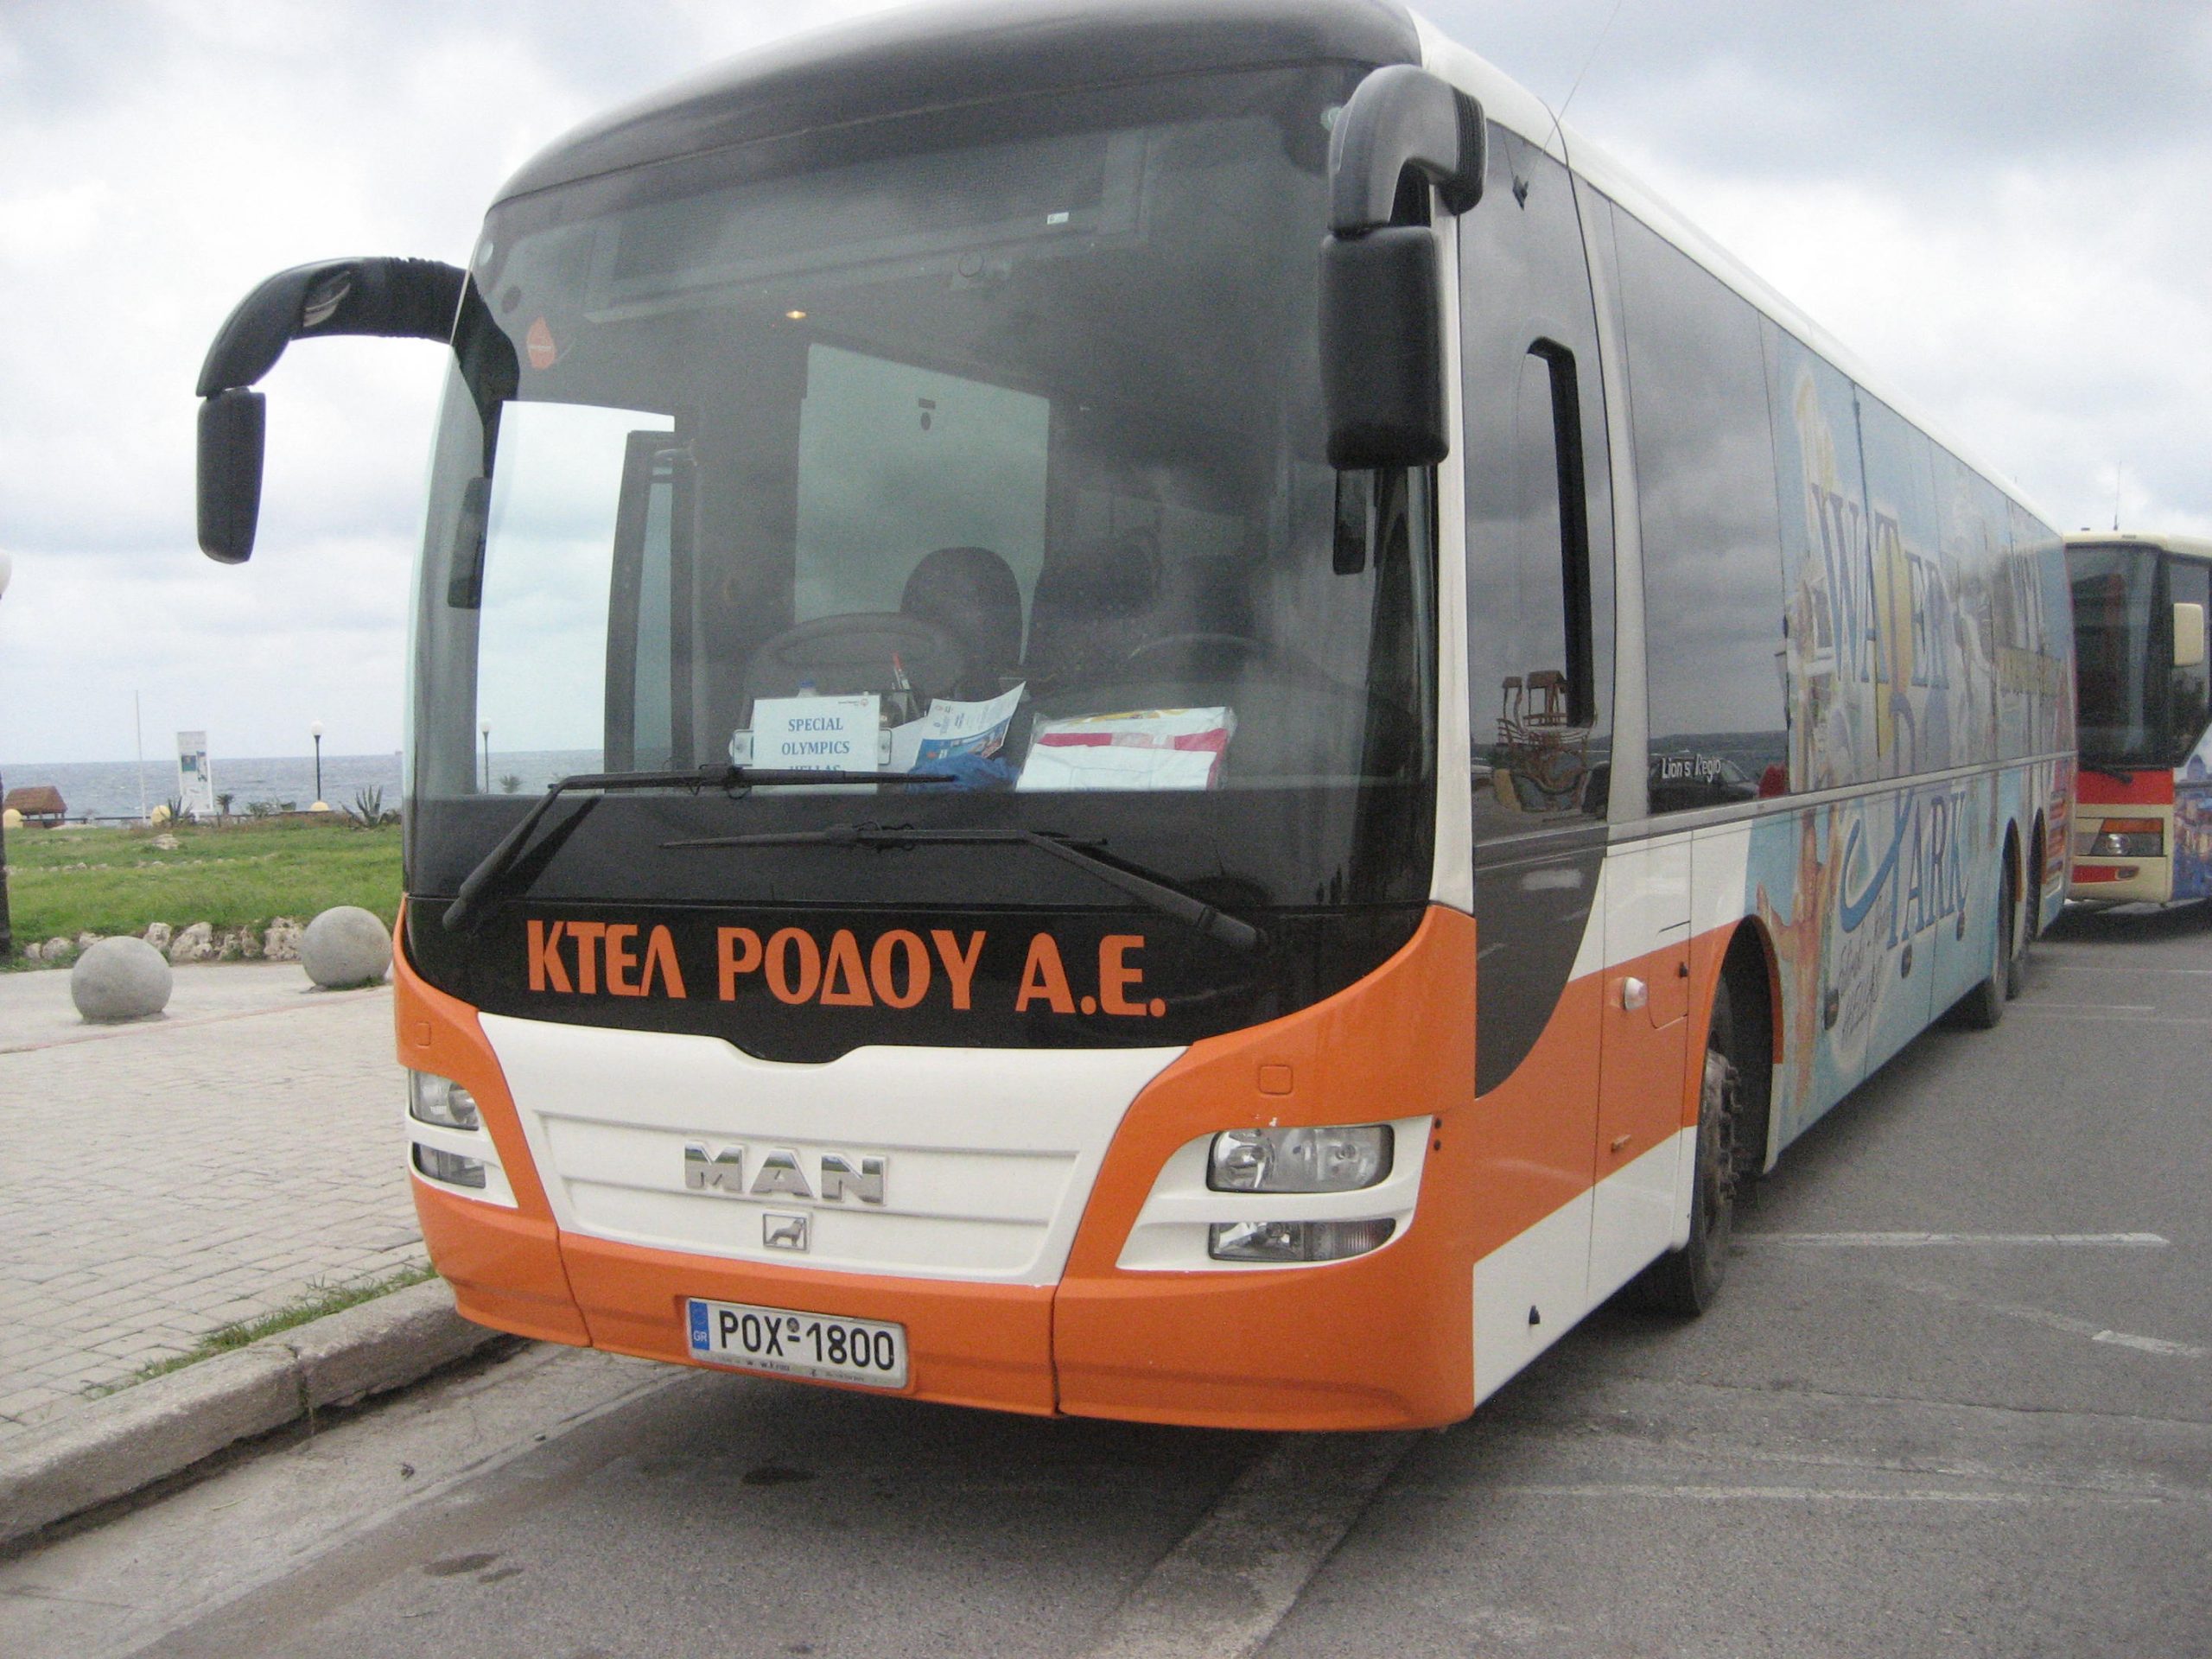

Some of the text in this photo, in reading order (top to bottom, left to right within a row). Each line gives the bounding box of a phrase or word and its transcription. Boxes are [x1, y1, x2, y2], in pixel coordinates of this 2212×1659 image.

[1811, 482, 1950, 690] WATER
[788, 717, 843, 732] SPECIAL
[782, 741, 850, 755] OLYMPICS
[1662, 753, 1721, 783] Lions Regio
[527, 919, 687, 999] ΚΤΕΛ
[717, 927, 988, 1009] ΡΟΔΟΥ
[683, 1141, 887, 1205] MAN
[693, 1330, 708, 1342] GR
